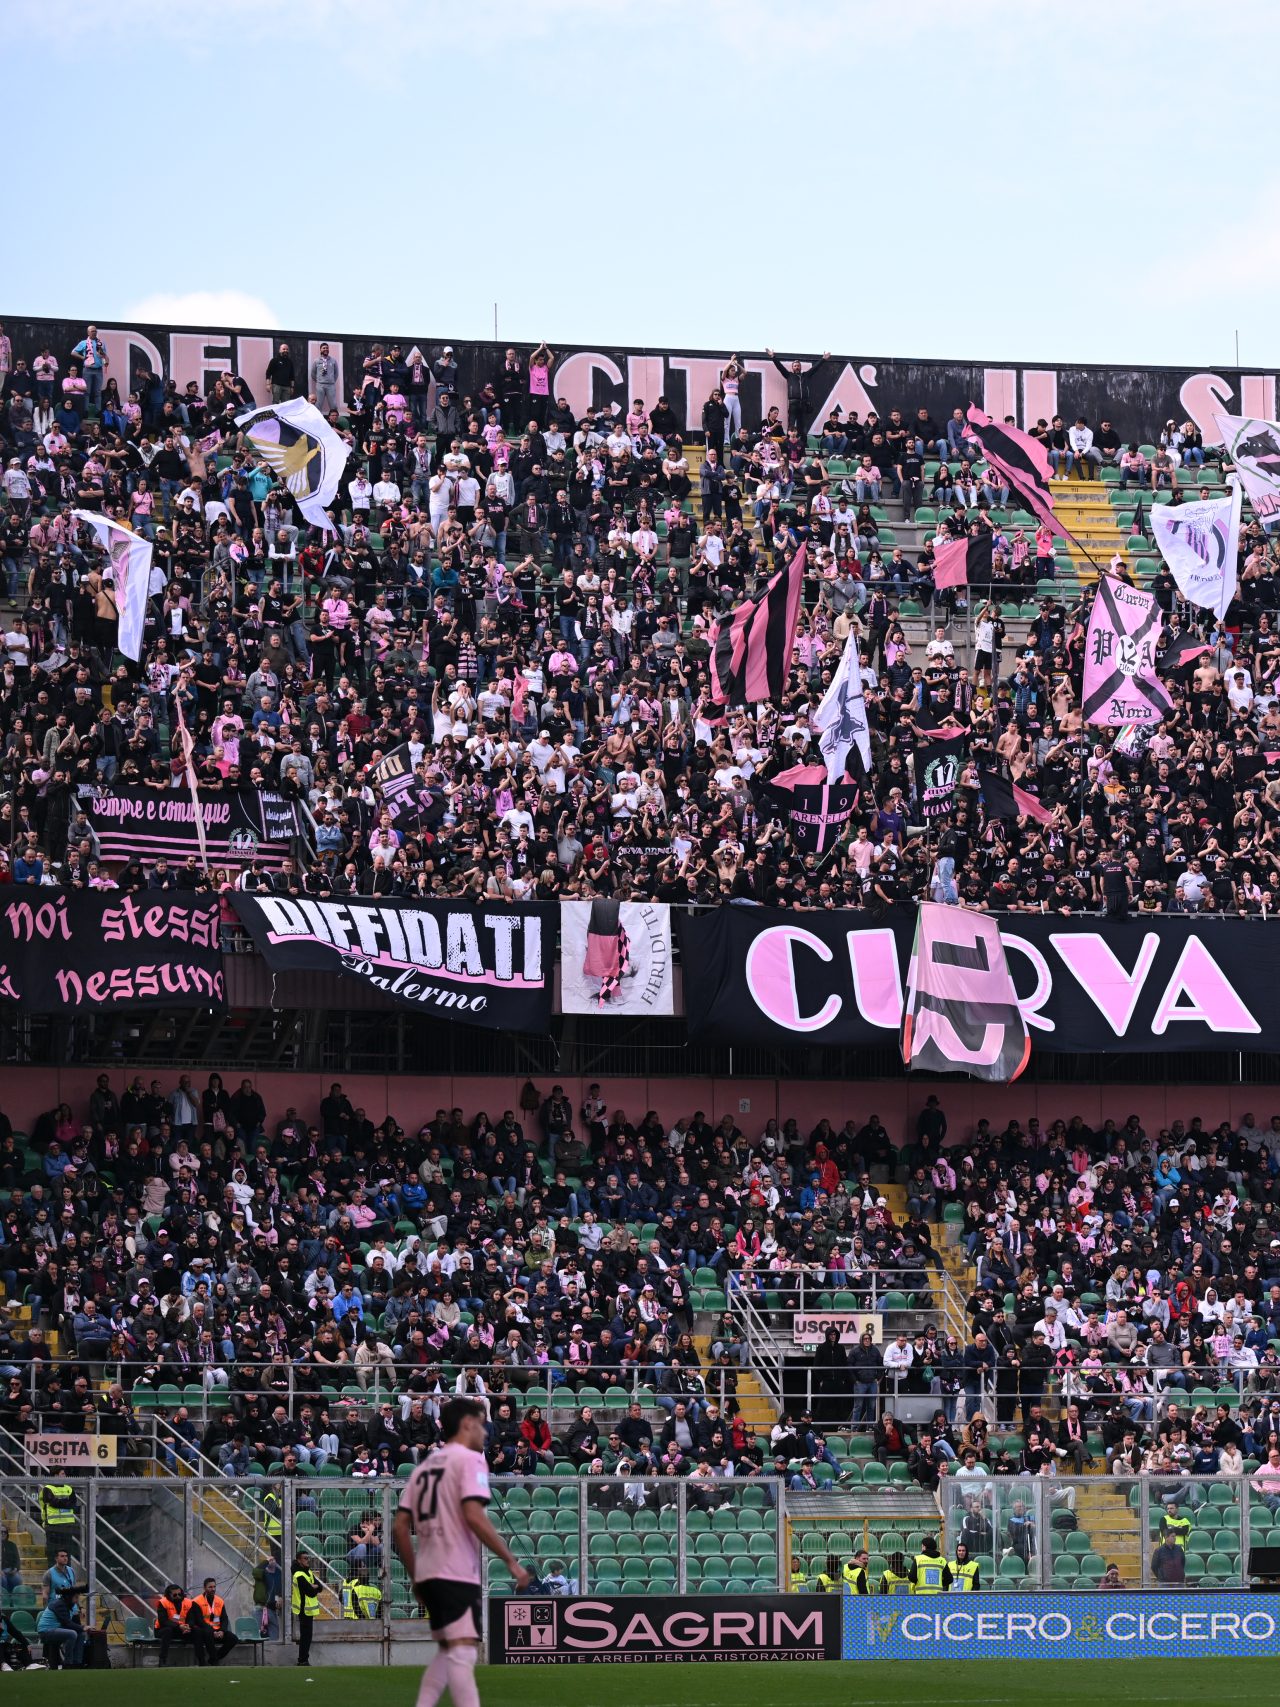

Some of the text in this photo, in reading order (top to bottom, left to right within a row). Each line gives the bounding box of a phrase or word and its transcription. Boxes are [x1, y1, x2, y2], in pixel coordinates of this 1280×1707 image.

[1107, 698, 1153, 724] Nord
[146, 800, 156, 821] e
[4, 895, 220, 950] noi stessi
[252, 896, 542, 981] DIFFIDATI
[640, 905, 666, 1006] FIERI DI TE
[0, 964, 20, 1000] i
[340, 953, 488, 1012] Palermo
[795, 1320, 875, 1336] USCITA 8
[26, 1440, 108, 1459] USCITA 6
[415, 1467, 446, 1523] 27
[563, 1601, 823, 1649] SAGRIM
[505, 1655, 571, 1664] IMPIANTI
[592, 1654, 648, 1662] ARREDI
[654, 1654, 684, 1662] PER
[690, 1653, 707, 1661] LA
[715, 1652, 825, 1661] RISTORAZIONE
